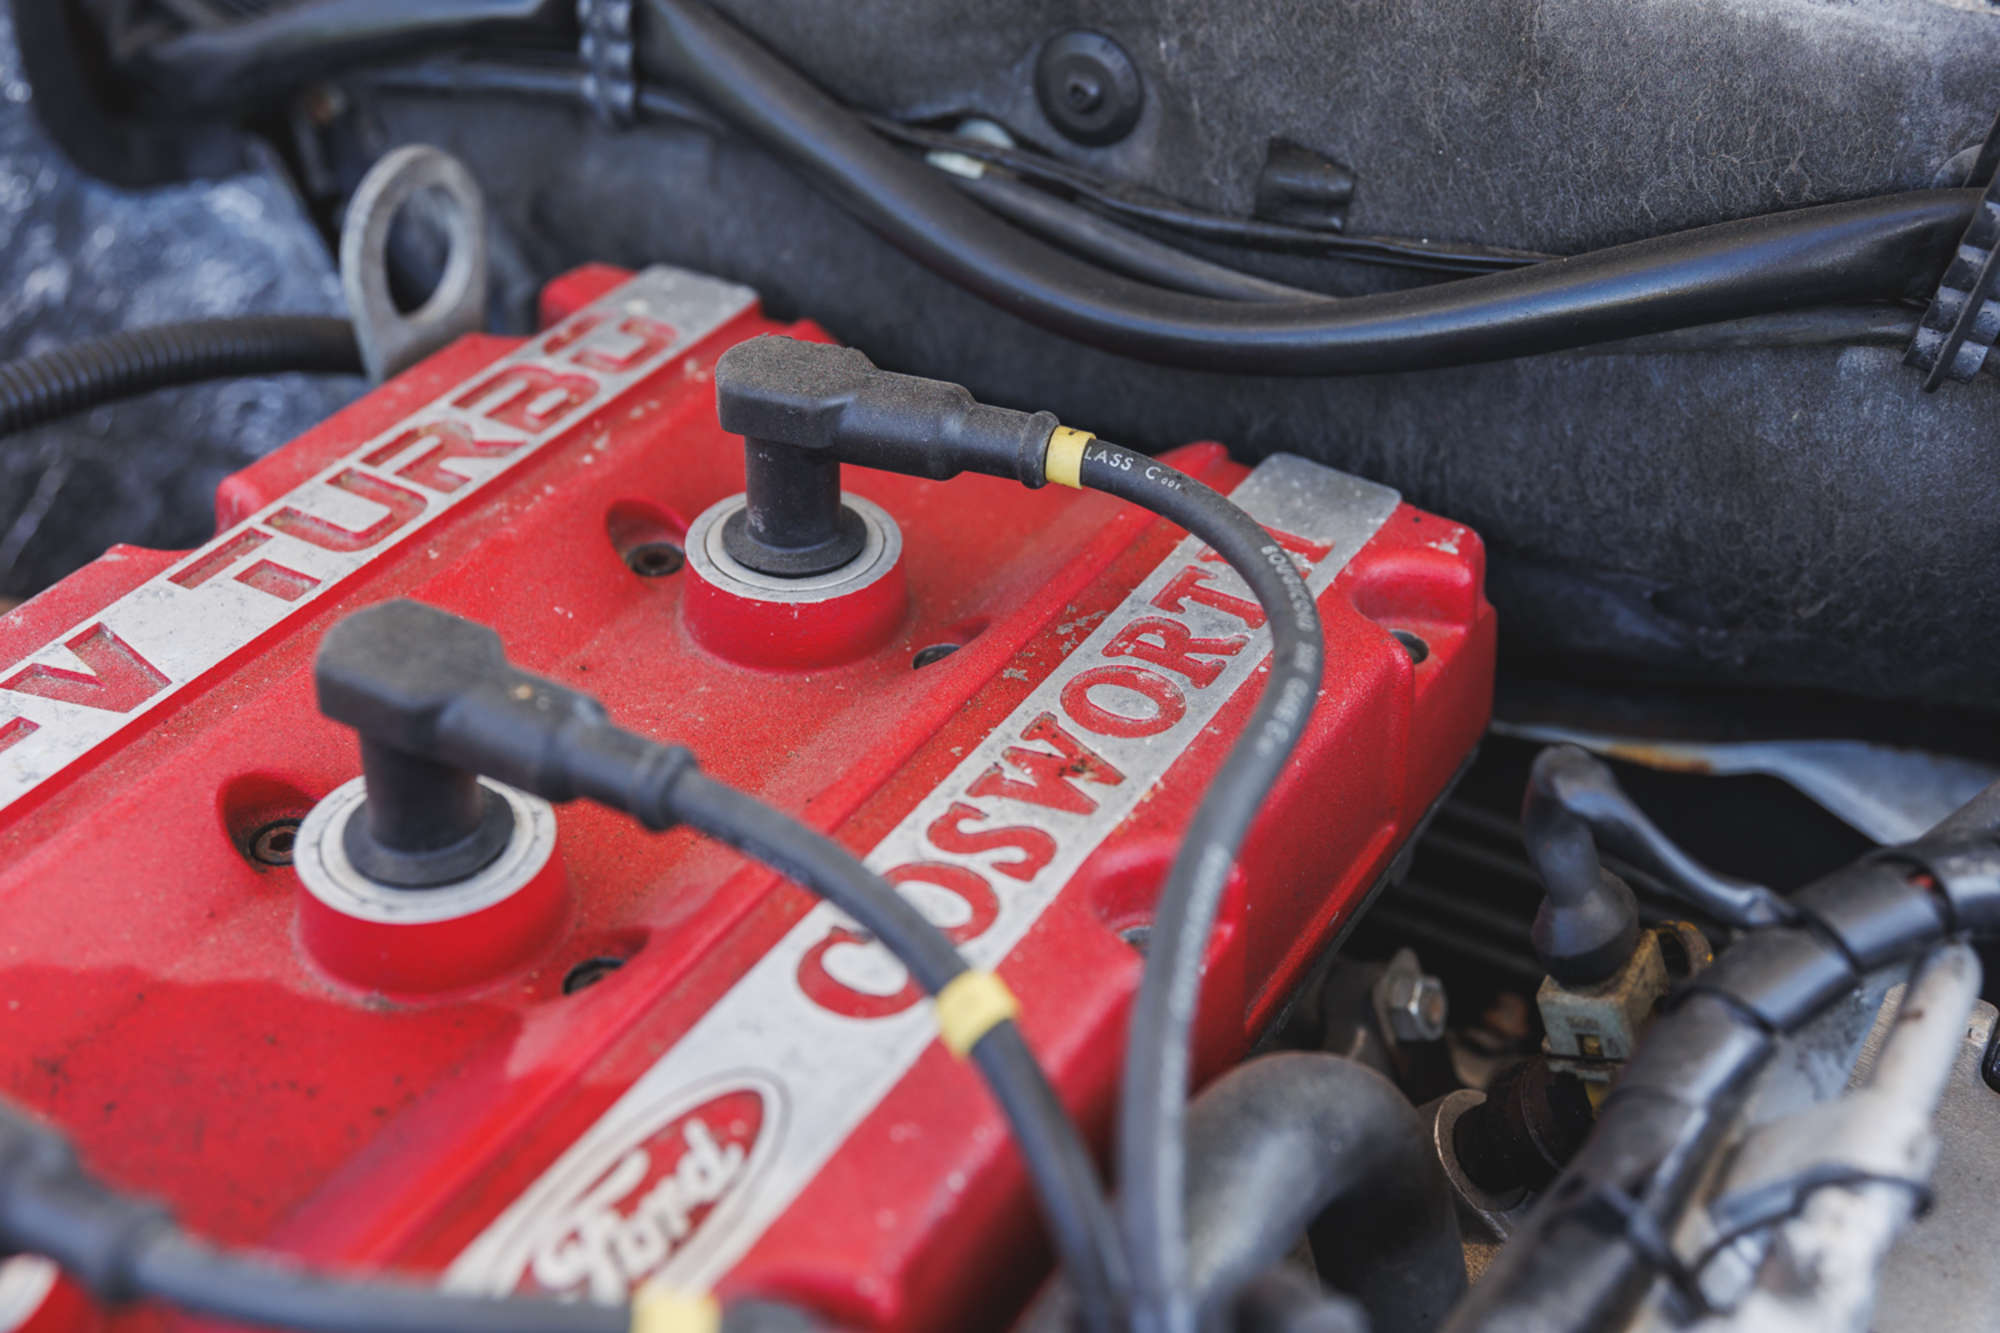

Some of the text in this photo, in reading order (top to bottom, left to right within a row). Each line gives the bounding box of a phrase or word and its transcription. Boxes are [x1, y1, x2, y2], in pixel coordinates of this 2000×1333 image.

[0, 309, 679, 754] V TURBO
[532, 1118, 746, 1308] Ford
